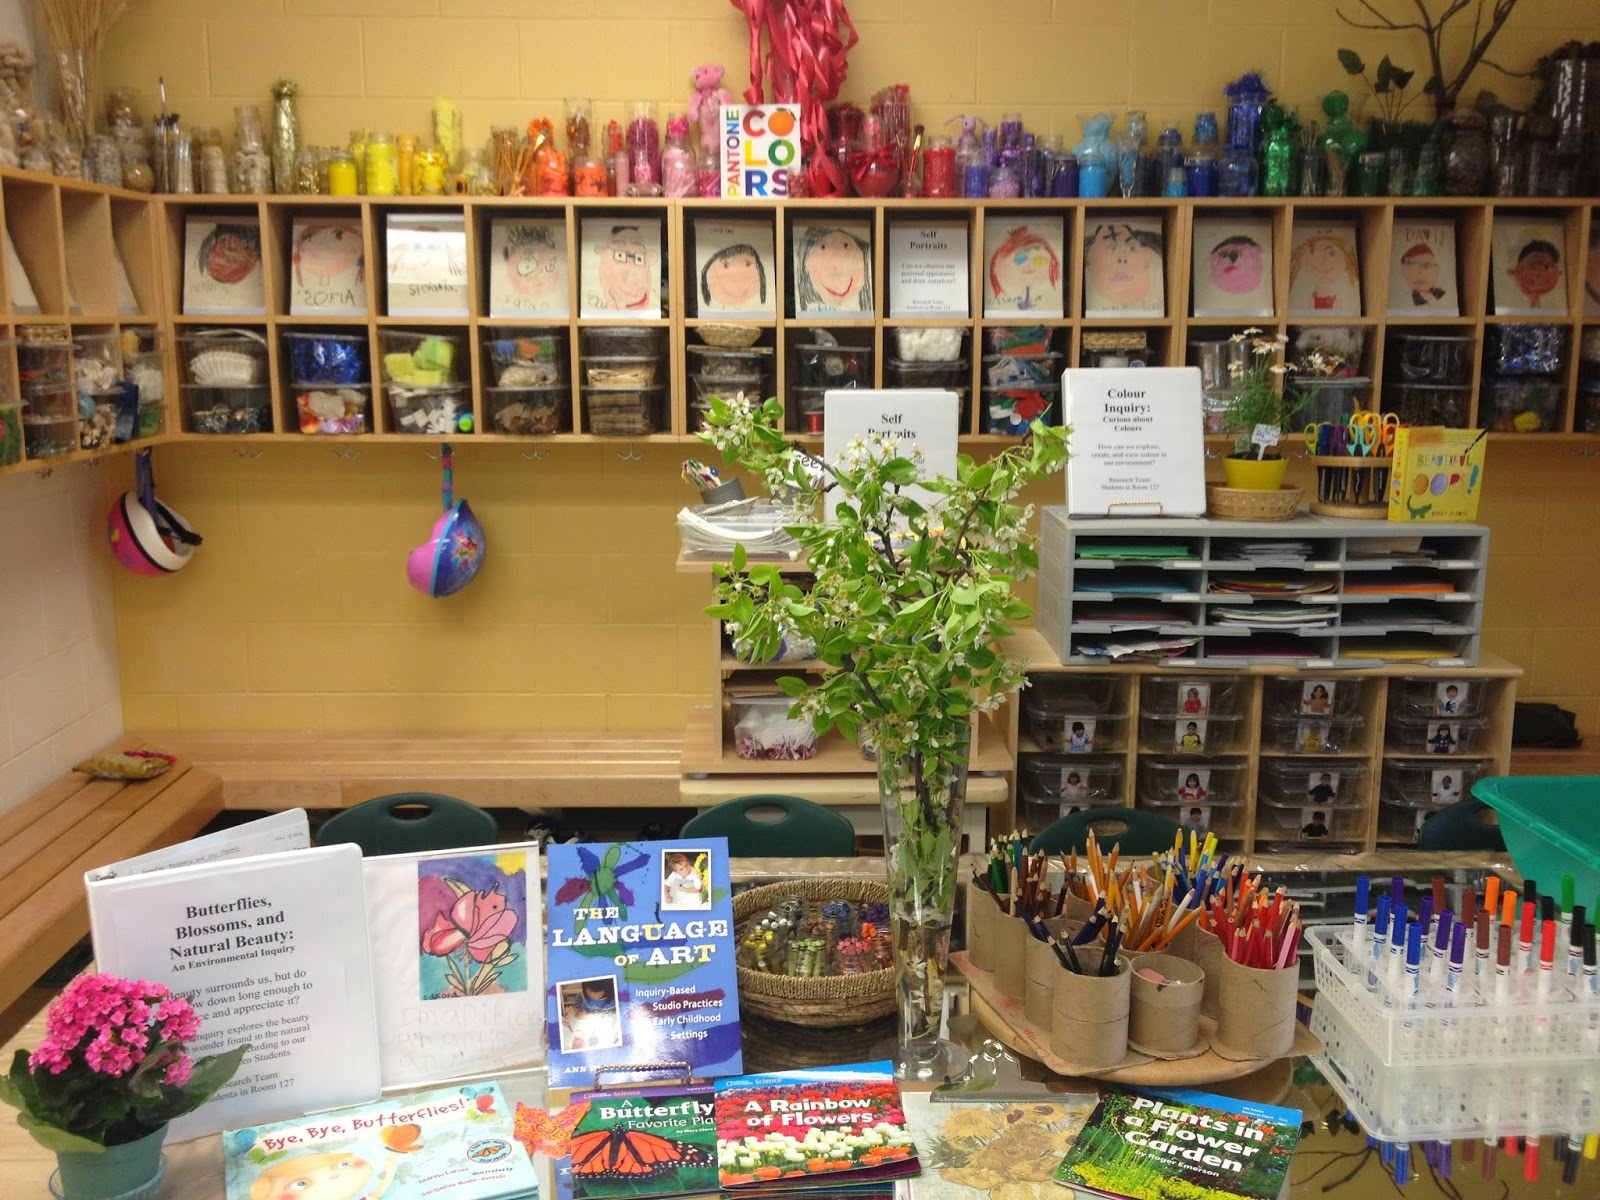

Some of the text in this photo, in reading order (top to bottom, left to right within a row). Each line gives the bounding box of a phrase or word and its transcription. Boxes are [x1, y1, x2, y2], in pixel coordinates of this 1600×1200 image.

[726, 107, 740, 197] PANTONE
[920, 230, 937, 239] Self
[910, 241, 948, 250] Portraits
[1107, 388, 1147, 399] Colour
[1104, 402, 1151, 415] Inquiry:
[881, 413, 904, 424] Self
[1102, 415, 1153, 423] Curious about
[1135, 443, 1160, 451] explore,
[186, 897, 272, 919] Butterflies,
[574, 906, 619, 921] THE
[175, 911, 285, 940] Blossoms, and
[552, 919, 728, 947] LANGUAGE
[169, 928, 294, 960] Natural Beauty:
[171, 944, 296, 973] An Environmental Inquiry
[614, 944, 716, 966] OF ART
[166, 968, 307, 1001] Beauty surrounds us, but do
[635, 985, 697, 998] Inquiry-Based
[207, 995, 236, 1007] down
[238, 990, 261, 1004] long
[263, 981, 301, 997] enough
[303, 981, 313, 990] to
[212, 1007, 231, 1019] and
[233, 999, 285, 1016] appreciate
[287, 995, 300, 1006] it?
[652, 998, 724, 1011] Studio Practices
[227, 1022, 264, 1036] explores
[265, 1016, 280, 1026] the
[281, 1014, 310, 1027] beauty
[652, 1012, 722, 1027] Early Childhood
[191, 1040, 225, 1053] wonder
[227, 1034, 252, 1046] found
[254, 1033, 263, 1041] in
[265, 1029, 279, 1039] the
[280, 1023, 310, 1037] natural
[281, 1039, 290, 1047] to
[291, 1036, 306, 1045] our
[670, 1028, 708, 1040] Settings
[254, 1049, 294, 1063] Students.
[254, 1071, 281, 1083] Team:
[564, 1066, 588, 1074] ANN
[239, 1088, 249, 1097] in
[250, 1083, 277, 1095] Room
[279, 1078, 295, 1089] 127
[755, 1077, 782, 1085] Science
[621, 1099, 633, 1108] A
[743, 1097, 871, 1113] A Rainbow
[263, 1098, 466, 1151] Bye, Bye, Butterflies!
[628, 1116, 717, 1130] Favorite Pla
[746, 1111, 873, 1127] of Flowers
[1132, 1096, 1265, 1142] Plants in
[1124, 1115, 1260, 1157] a Flower
[1124, 1129, 1243, 1173] Garden
[1134, 1148, 1220, 1178] by Roger Emerson
